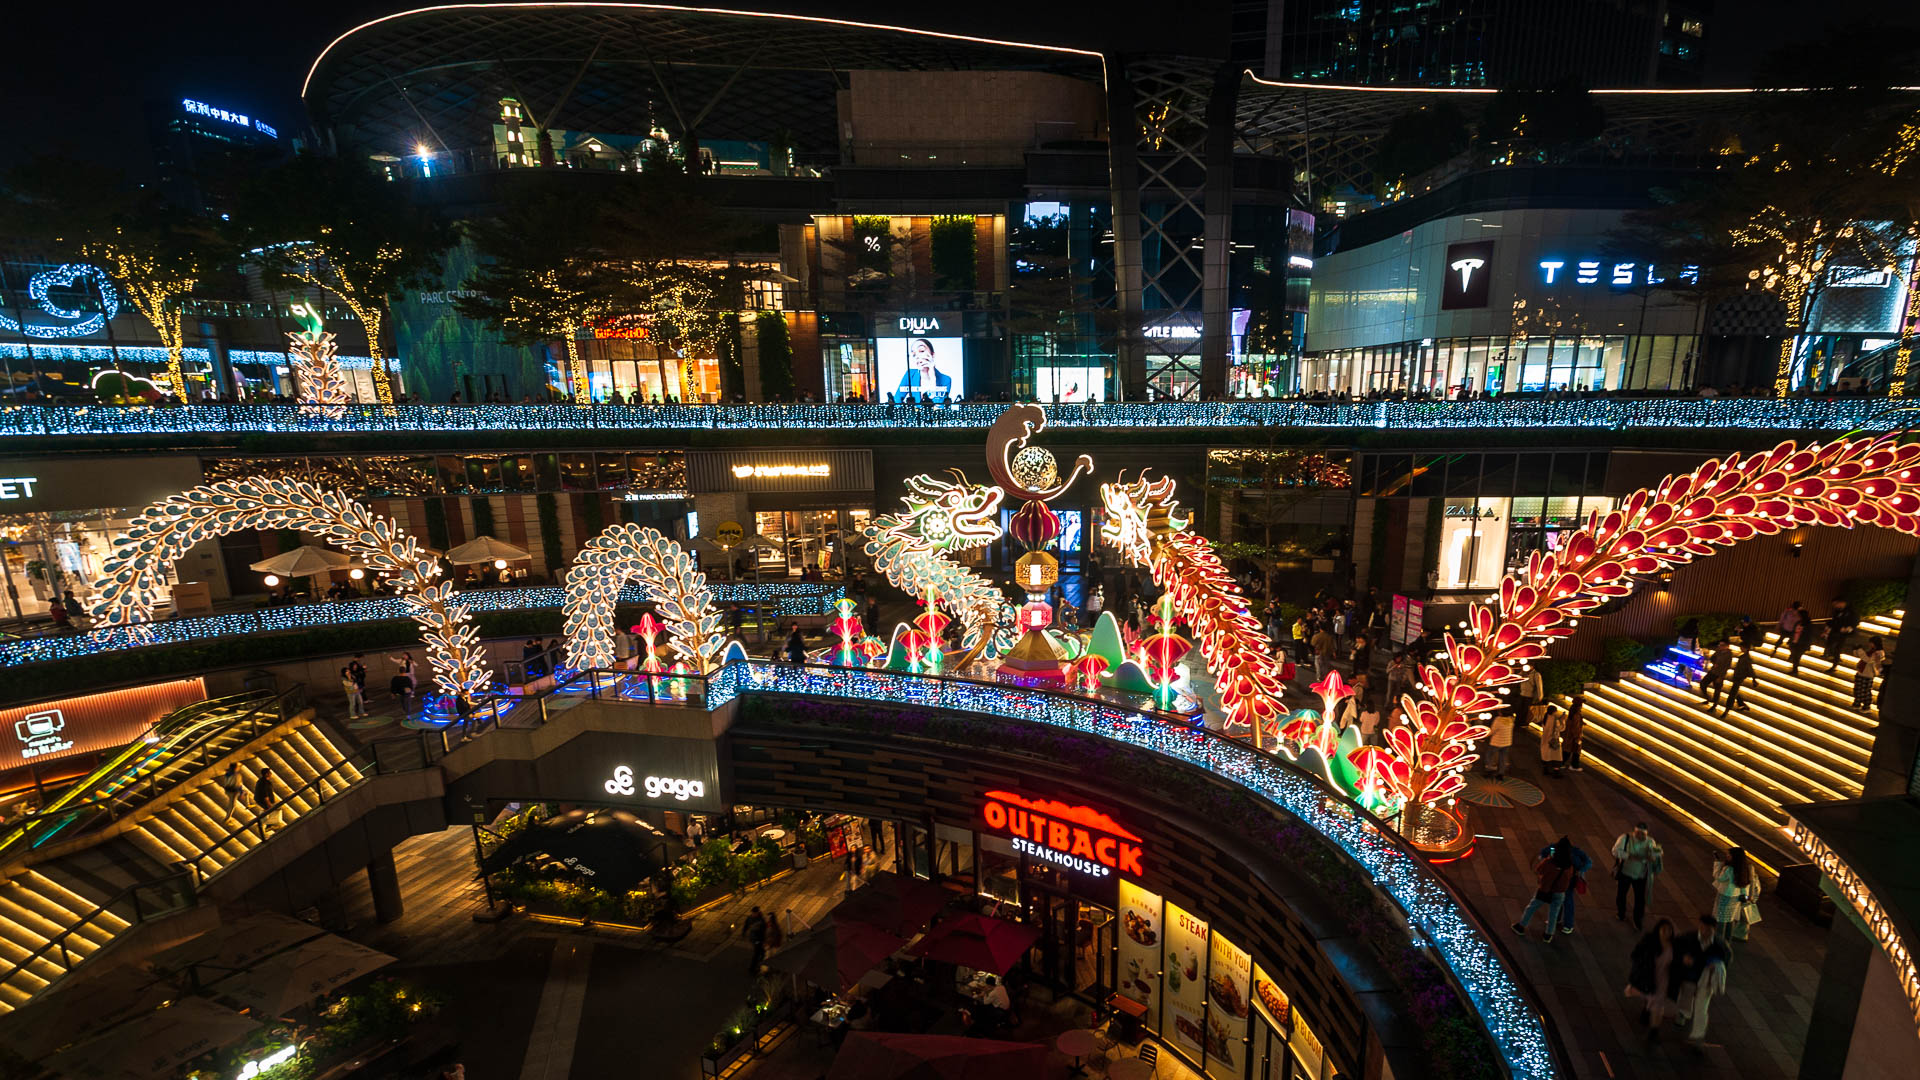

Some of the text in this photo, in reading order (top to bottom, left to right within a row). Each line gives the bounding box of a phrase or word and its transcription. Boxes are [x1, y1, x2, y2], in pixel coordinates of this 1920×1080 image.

[899, 317, 939, 331] DJULA
[644, 776, 704, 800] gaga
[984, 801, 1143, 877] OUTBACK
[1179, 914, 1207, 942] STEAK
[1213, 934, 1232, 960] WITH
[1234, 950, 1249, 973] YOU
